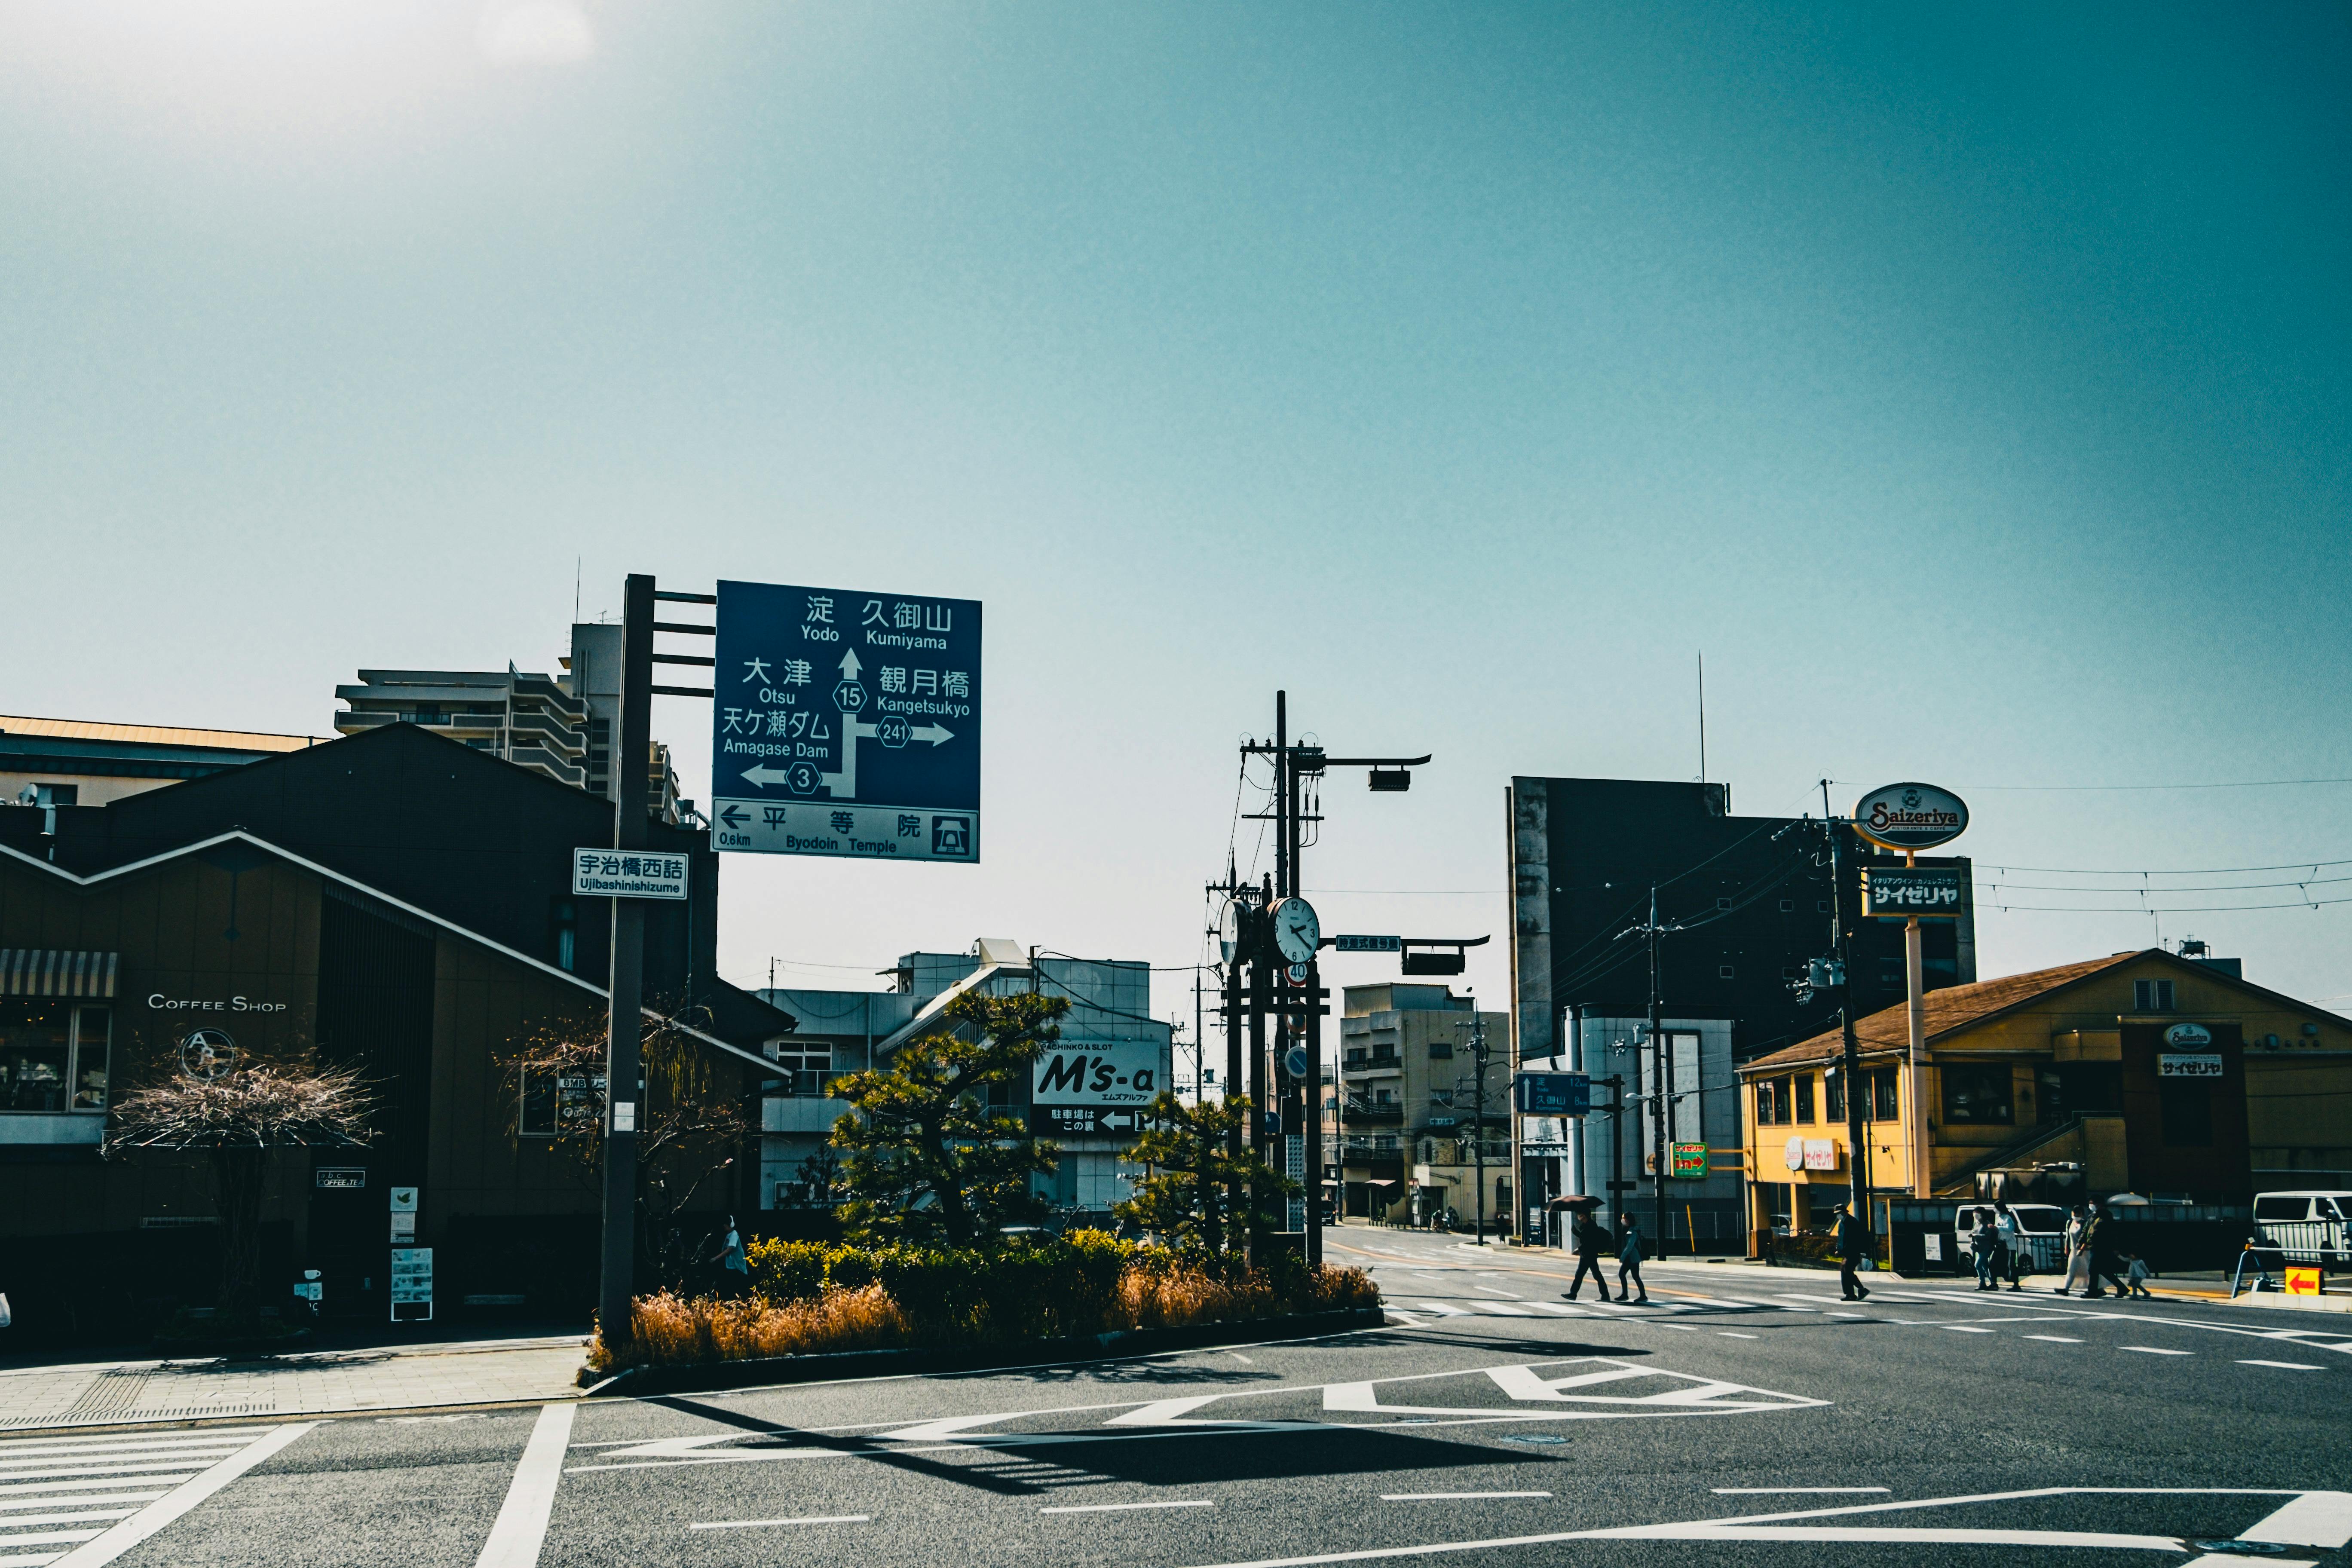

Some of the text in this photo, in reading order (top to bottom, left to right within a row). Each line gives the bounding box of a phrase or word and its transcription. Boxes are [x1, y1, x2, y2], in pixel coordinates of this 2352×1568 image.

[807, 596, 834, 623] 淀
[862, 600, 951, 631] 久御山
[801, 625, 839, 641] Yodo
[867, 630, 946, 649] Kumiyama
[743, 657, 812, 686] 大津
[879, 665, 969, 698] 観月橋
[759, 688, 795, 704] Otsu
[839, 687, 860, 706] 15
[878, 696, 970, 718] Kangetsukyo
[883, 724, 905, 740] 241
[724, 739, 828, 758] Amagase Dam
[797, 769, 809, 787] 3
[1869, 802, 1959, 828] Saizeriya
[720, 832, 750, 847] 0.6km
[787, 835, 897, 854] Byodoin Temple
[579, 854, 683, 879] 宇治橋西詰
[580, 878, 680, 893] Ujibashinishizume
[1875, 886, 1957, 904] サイゼリヤ
[1291, 901, 1298, 910] 12
[1310, 928, 1315, 937] 3
[1292, 952, 1297, 961] 6
[1291, 964, 1305, 977] 40
[2162, 1062, 2220, 1074] サイゼリヤ
[1536, 1096, 1565, 1105] 久御山
[1051, 1109, 1095, 1119] 駐車場は
[1063, 1121, 1094, 1131] この裏
[1675, 1154, 1692, 1169] in
[1806, 1150, 1831, 1167] サイゼリヤ
